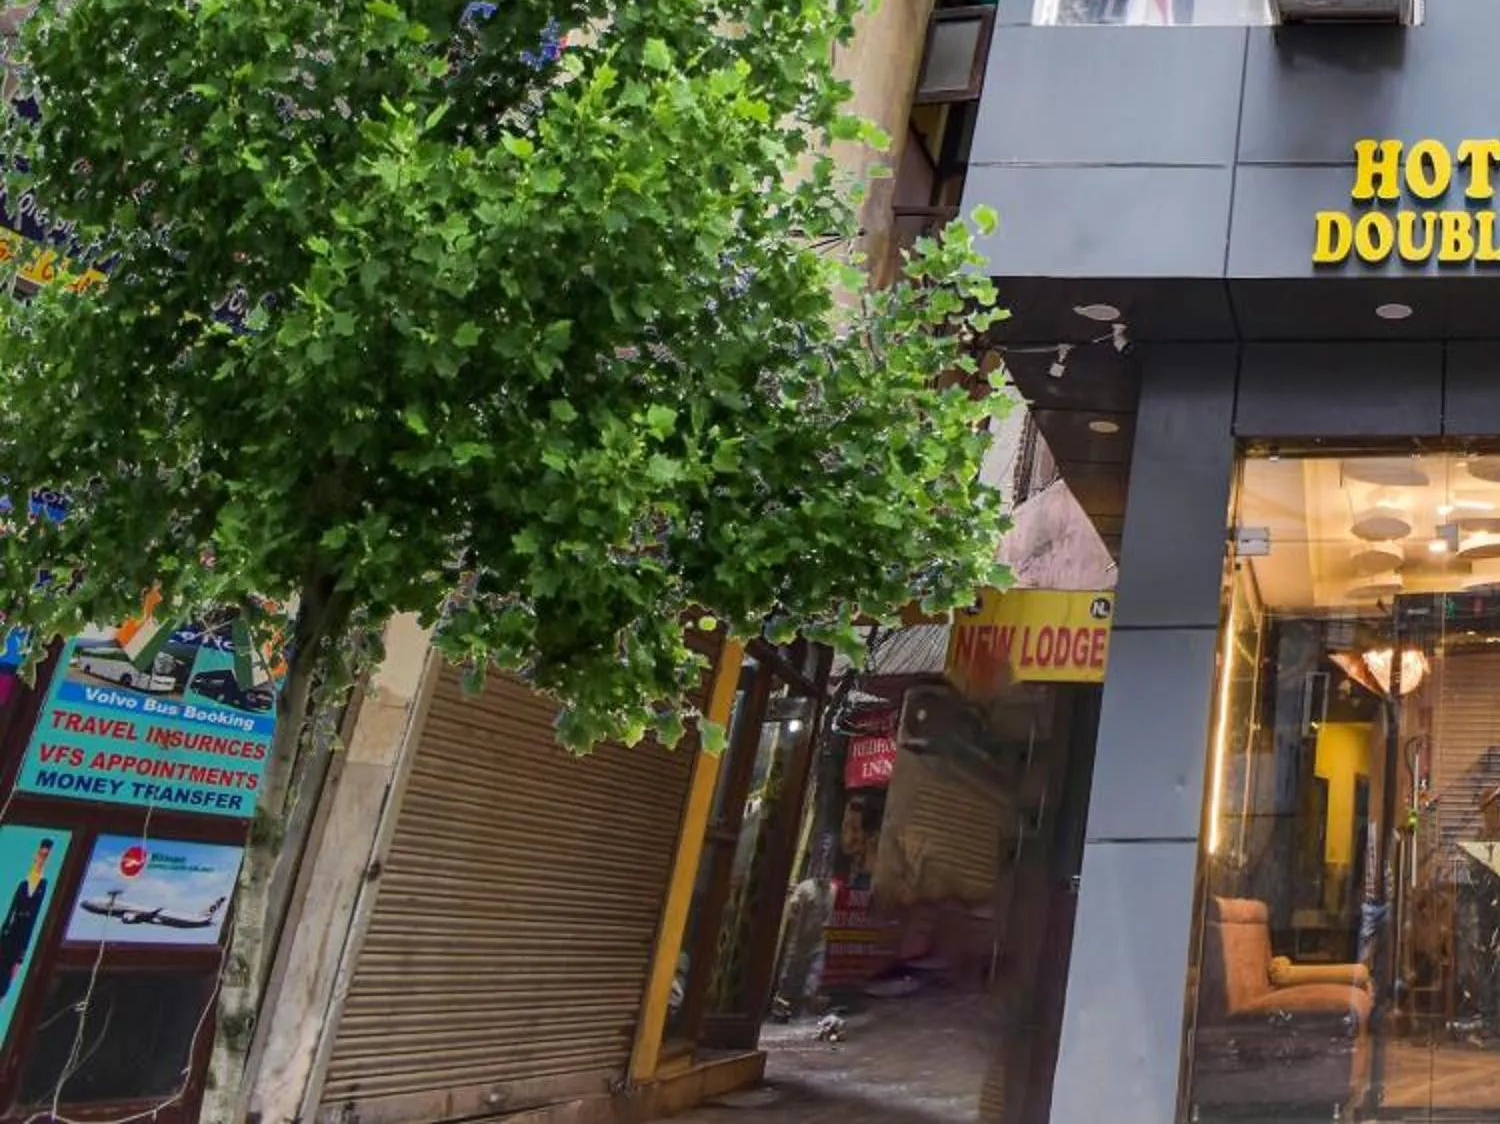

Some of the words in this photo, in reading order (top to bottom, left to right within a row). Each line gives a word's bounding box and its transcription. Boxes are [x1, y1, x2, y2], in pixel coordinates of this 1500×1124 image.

[1019, 625, 1108, 669] LODGE
[51, 709, 139, 742] TRAVEL
[85, 686, 137, 709] Volvo
[143, 697, 179, 716] Bus
[183, 704, 255, 731] Booking
[39, 743, 85, 767] VFS
[89, 750, 259, 790] APPOINTMENTS
[35, 771, 125, 795] MONEY
[132, 781, 244, 811] TRANSFER
